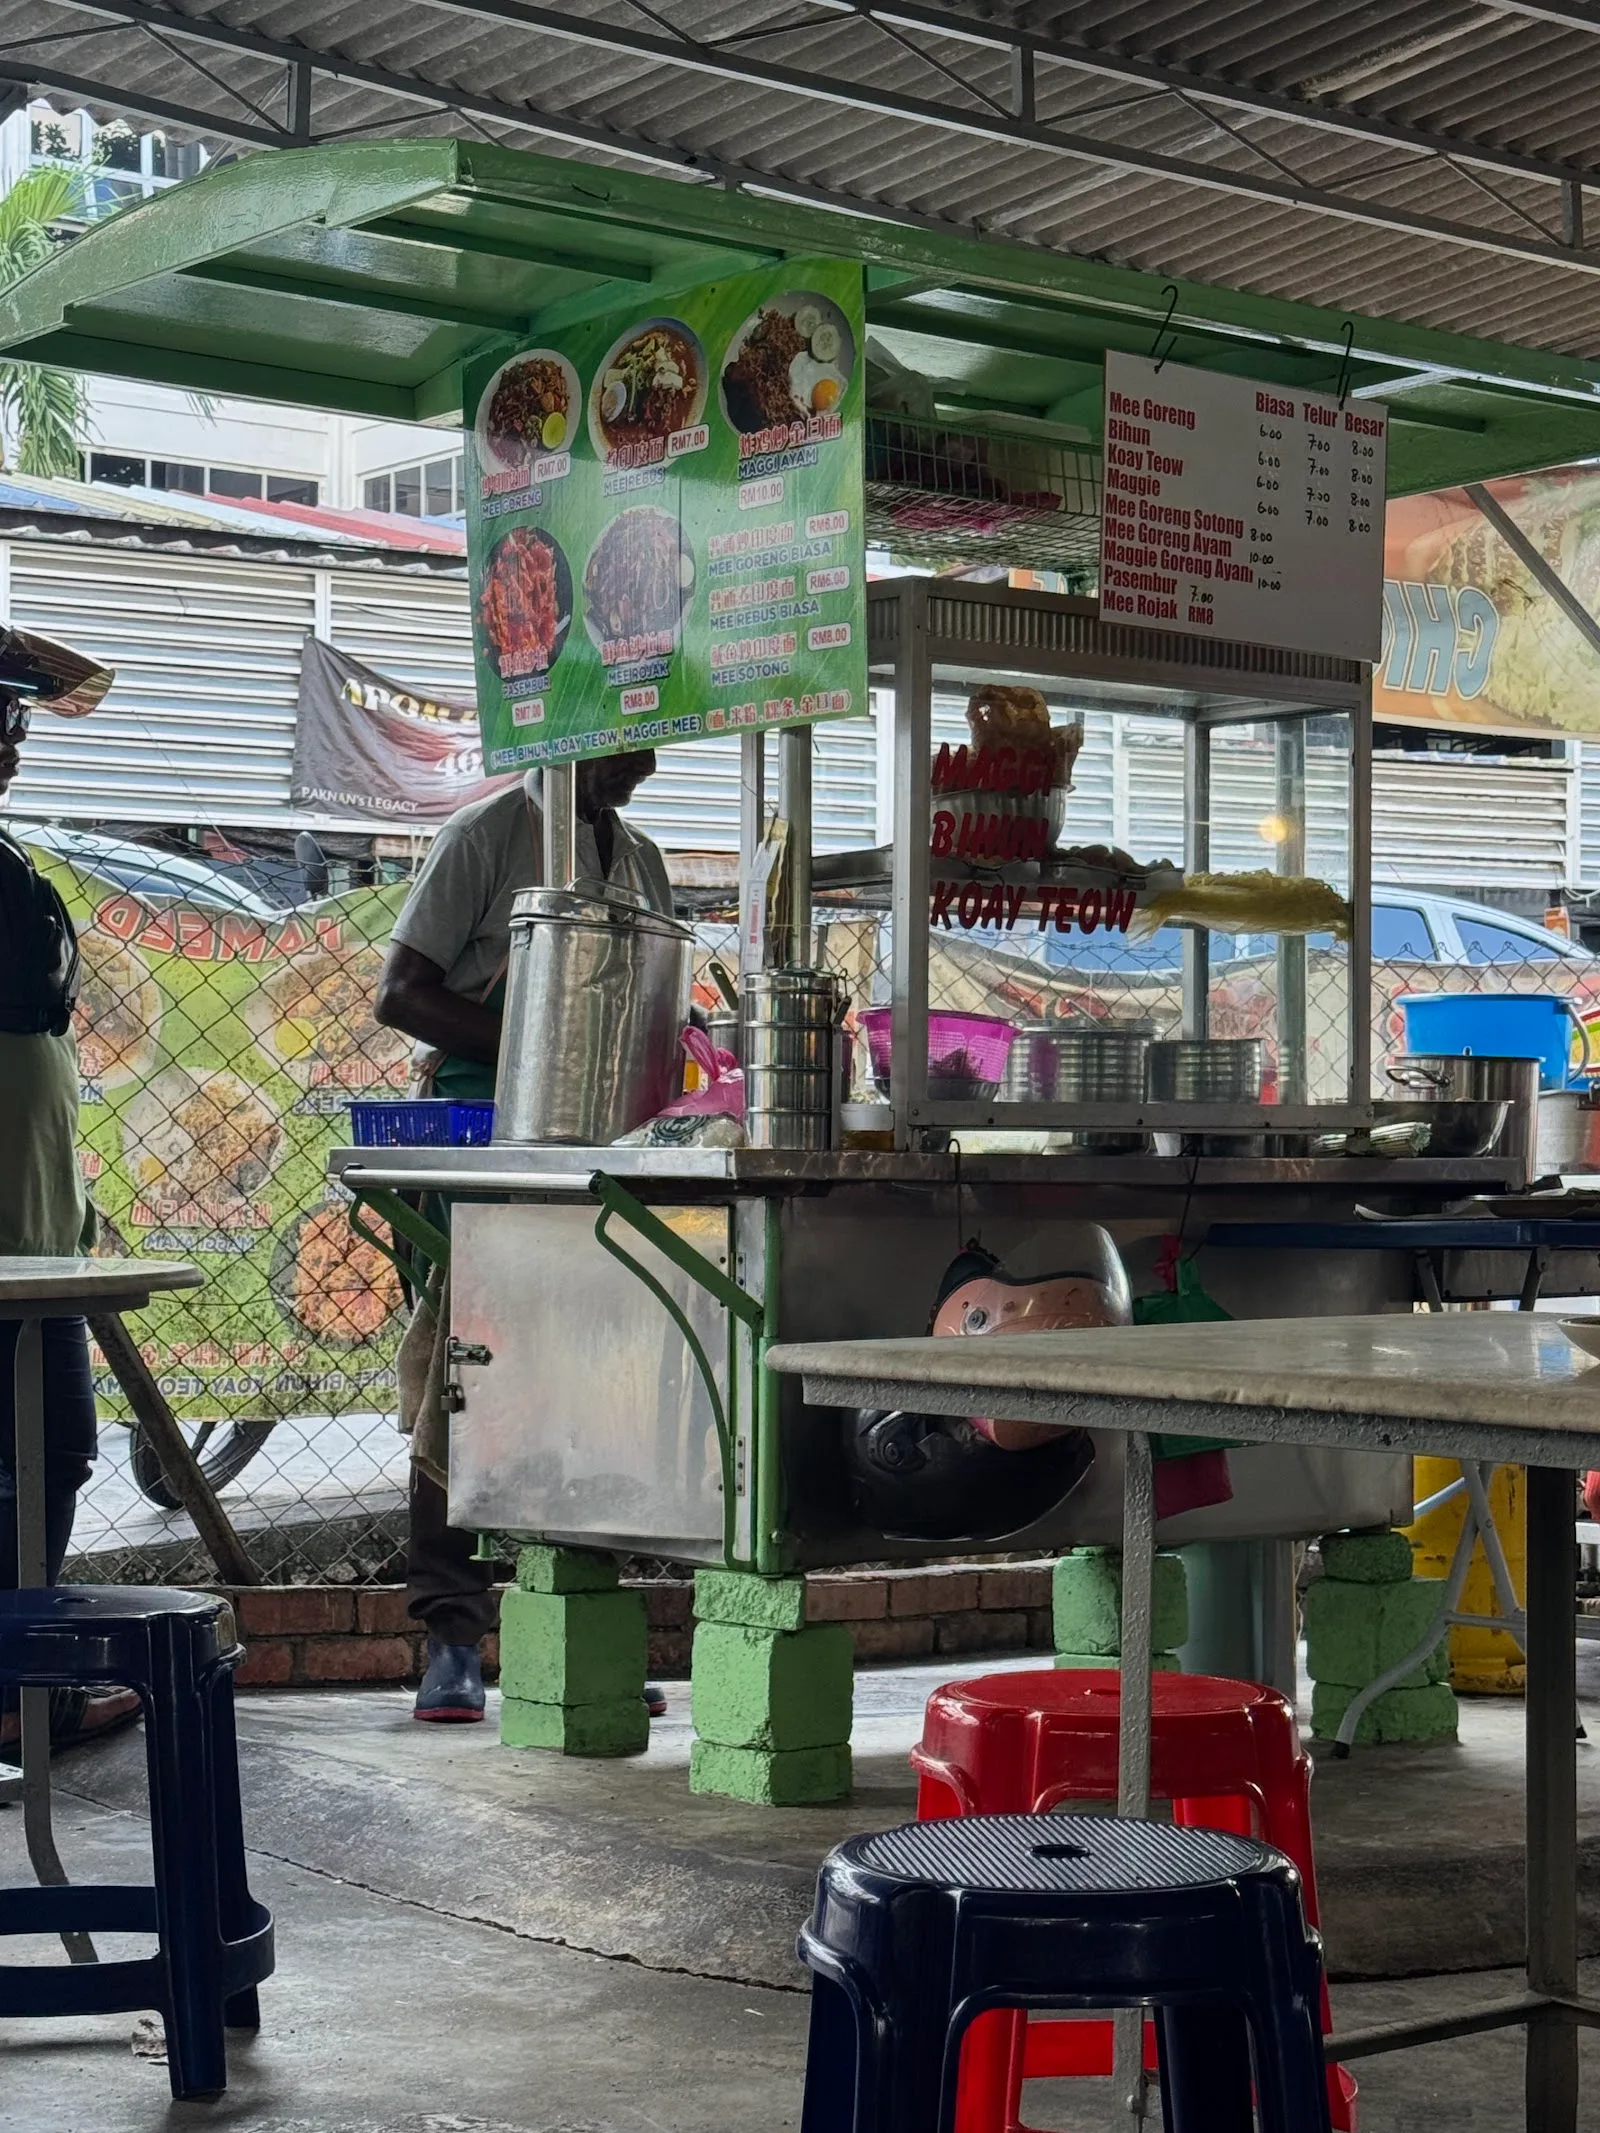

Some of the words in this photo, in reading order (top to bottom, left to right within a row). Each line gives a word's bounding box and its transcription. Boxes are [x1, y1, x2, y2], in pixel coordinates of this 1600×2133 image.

[1109, 391, 1140, 417] Mee
[1143, 398, 1196, 431] Goreng
[1256, 391, 1294, 418] Biasa
[1302, 402, 1338, 428] Telur
[1344, 411, 1384, 437] Besar
[671, 430, 705, 452] RM7.00
[1108, 418, 1151, 446] Bihun
[537, 461, 568, 477] RM7.00
[739, 456, 779, 476] MAGGI
[781, 448, 817, 468] AYAM
[1107, 443, 1143, 471] Koay
[1146, 450, 1184, 476] Teow
[604, 476, 627, 494] MEE
[628, 466, 664, 486] REBUS
[740, 483, 782, 504] RM10.00
[1107, 467, 1161, 497] Maggie
[482, 503, 500, 517] MEE
[502, 491, 542, 514] GORENG
[1105, 493, 1136, 517] Mee
[1139, 499, 1191, 530] Goreng
[1194, 509, 1244, 539] Sotong
[809, 515, 845, 533] RM6.00
[1105, 517, 1135, 541] Mee
[1138, 522, 1190, 552] Goreng
[1193, 532, 1232, 557] Ayam
[708, 561, 733, 577] MEE
[736, 550, 788, 571] GORENG
[791, 541, 831, 561] BIASA
[1104, 540, 1158, 568] Maggie
[1160, 550, 1212, 579] Goreng
[1214, 558, 1254, 584] Ayam
[810, 571, 846, 590] RM6.00
[1104, 564, 1178, 595] Pasembur
[710, 616, 734, 631] MEE
[736, 606, 777, 625] REBUS
[780, 602, 820, 617] BIASA
[1103, 590, 1134, 613] Mee
[1137, 595, 1178, 620] Rojak
[1188, 605, 1214, 625] RM8
[811, 628, 847, 646] RM8.00
[503, 677, 550, 697] PASEMBUR
[608, 668, 631, 685] MEE
[632, 661, 669, 680] ROJAK
[711, 671, 735, 685] MEE
[738, 661, 790, 680] SOTONG
[624, 691, 655, 706] RM8.00
[515, 705, 542, 721] RM7.00
[490, 750, 517, 769] (MEE,
[517, 742, 552, 760] BIHUN,
[554, 736, 584, 755] KOAY
[585, 731, 621, 748] TEOW,
[623, 722, 669, 742] MAGGIE
[672, 714, 703, 735] MEE)
[301, 787, 366, 807] PAKNAN's
[367, 798, 419, 813] LEGACY
[932, 810, 1050, 861] BIHUN
[930, 880, 1028, 931] KOAY
[1036, 886, 1138, 935] TEOW
